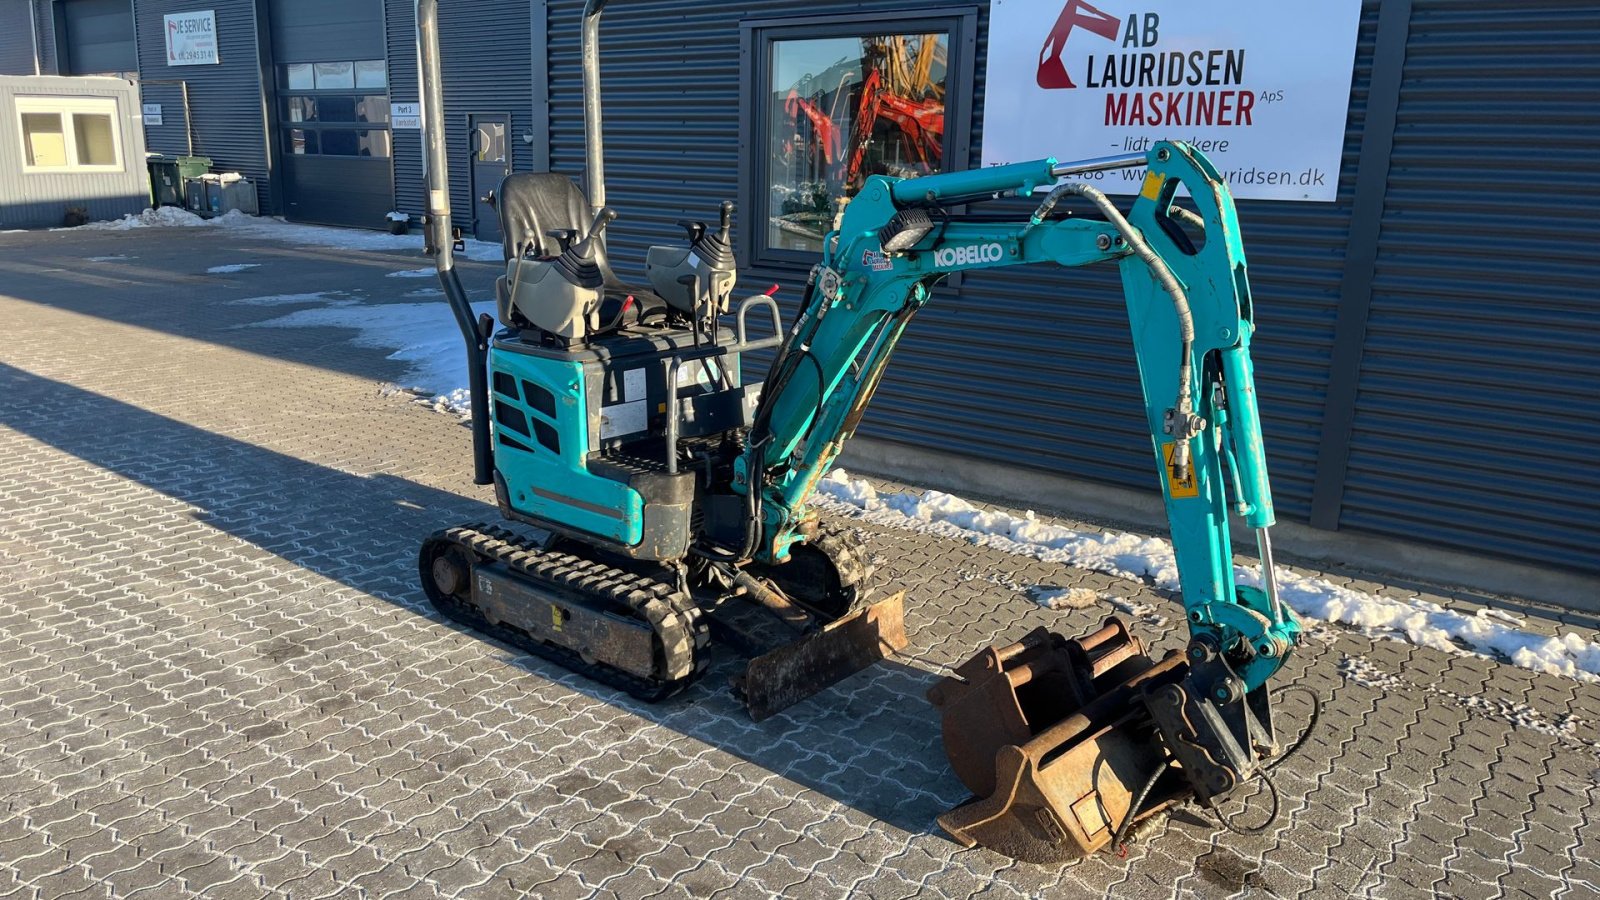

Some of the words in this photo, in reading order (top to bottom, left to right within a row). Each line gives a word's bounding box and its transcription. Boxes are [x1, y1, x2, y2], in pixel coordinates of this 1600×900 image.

[177, 20, 184, 34] JE
[184, 17, 212, 33] SERVICE
[1122, 12, 1160, 48] AB
[1086, 49, 1245, 88] LAURIDSEN
[1104, 90, 1255, 126] MASKINER
[1259, 90, 1284, 104] ApS
[1123, 135, 1150, 152] lidt
[934, 243, 1003, 267] KOBELCO
